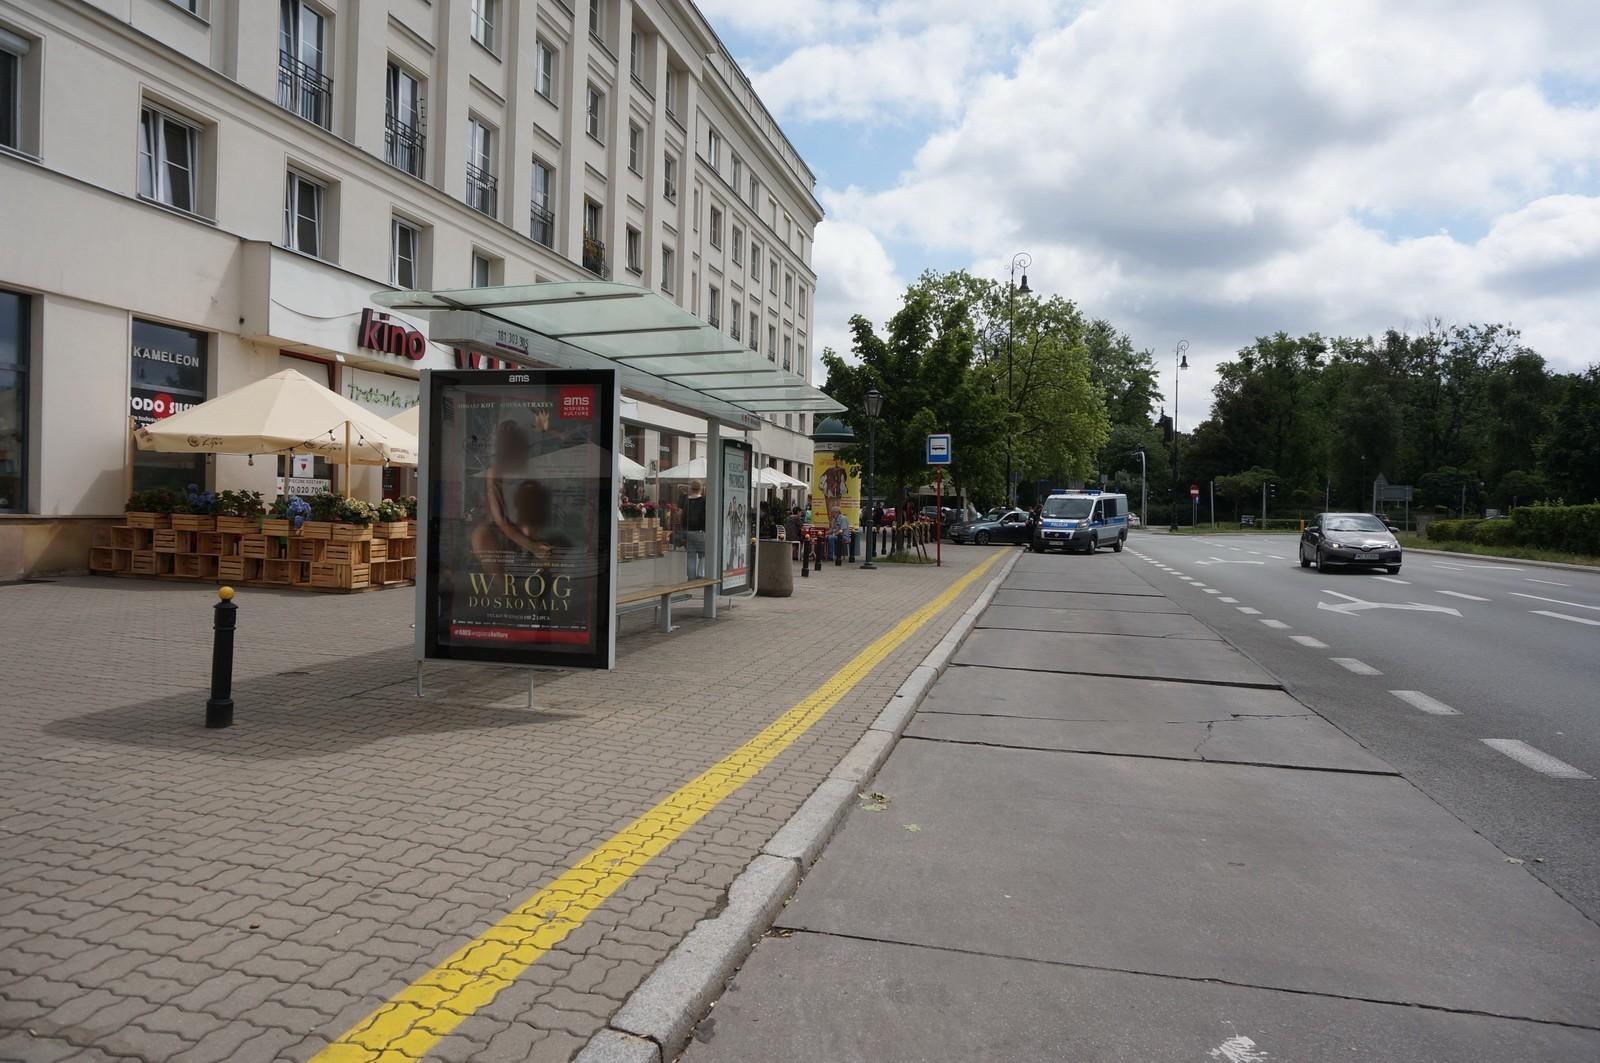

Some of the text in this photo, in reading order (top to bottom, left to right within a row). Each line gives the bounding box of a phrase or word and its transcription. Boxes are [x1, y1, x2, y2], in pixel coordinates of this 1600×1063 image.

[358, 308, 425, 360] kino
[133, 346, 199, 367] KAMELEON
[508, 374, 530, 383] ams
[129, 396, 165, 413] ODO
[563, 396, 590, 406] ams
[469, 569, 572, 598] WRÓG
